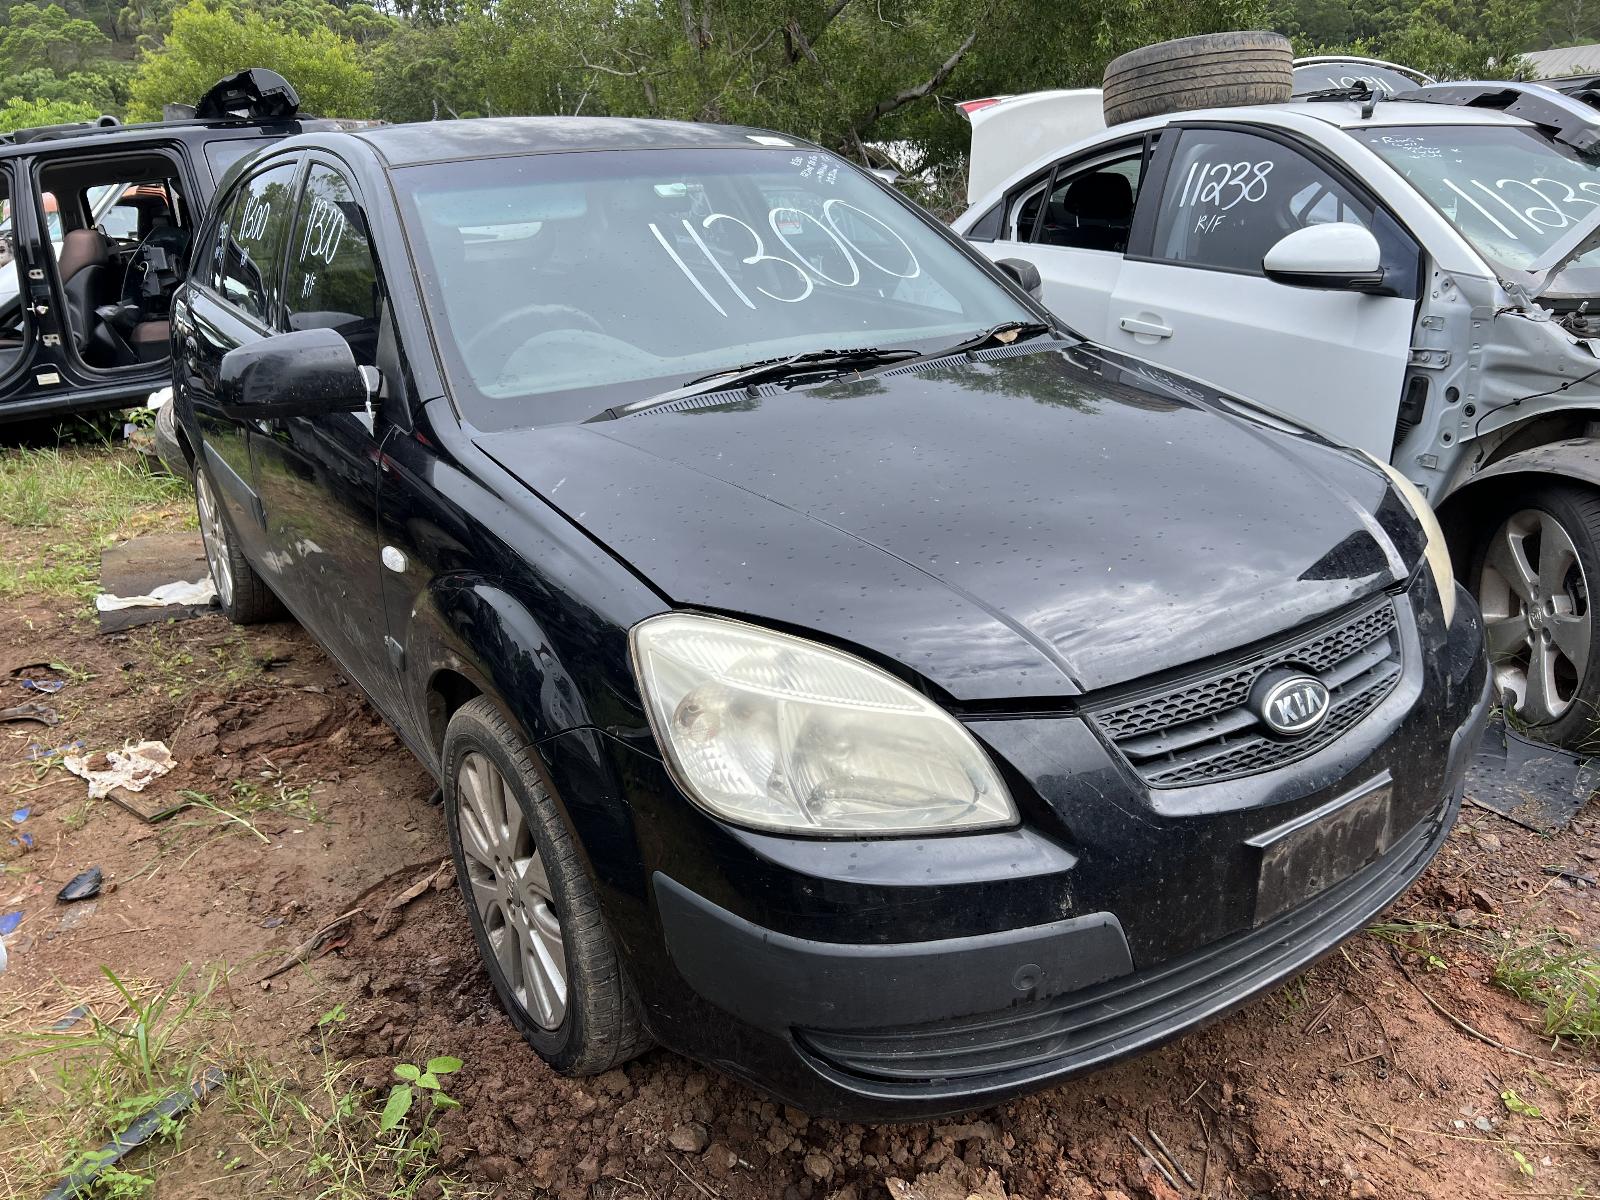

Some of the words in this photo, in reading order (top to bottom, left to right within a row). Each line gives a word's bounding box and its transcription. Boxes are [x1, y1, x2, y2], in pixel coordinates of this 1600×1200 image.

[1179, 160, 1274, 211] 11238
[239, 196, 271, 242] 11300
[300, 196, 345, 265] 11300
[1194, 214, 1227, 234] R/F
[648, 199, 921, 318] 11300
[1274, 686, 1324, 726] KIA
